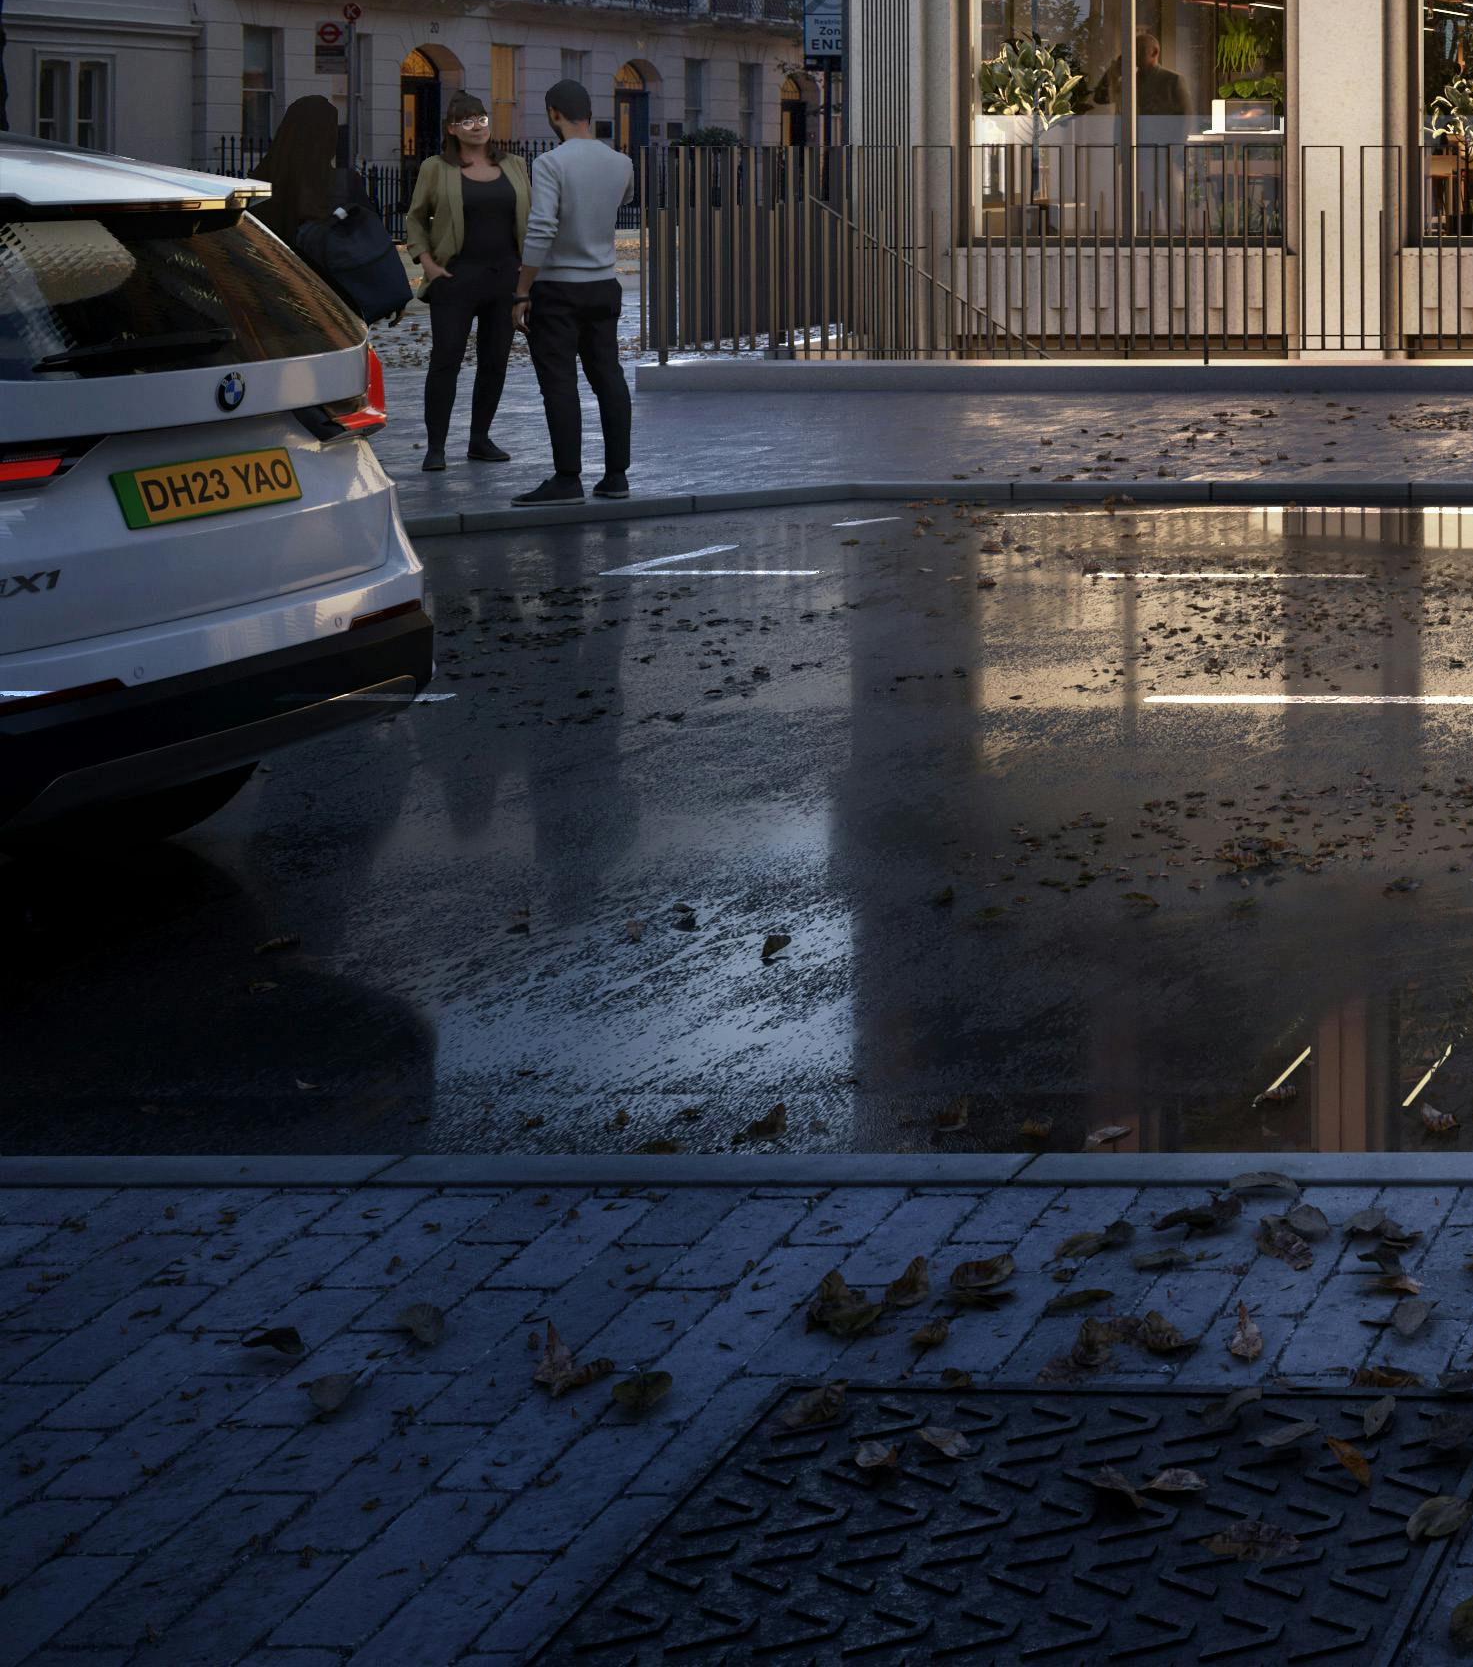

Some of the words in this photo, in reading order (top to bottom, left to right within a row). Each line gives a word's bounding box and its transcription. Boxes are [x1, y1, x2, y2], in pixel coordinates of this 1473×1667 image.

[346, 5, 357, 18] K
[430, 21, 440, 34] 20
[140, 468, 230, 512] DH23
[231, 458, 292, 495] YAO
